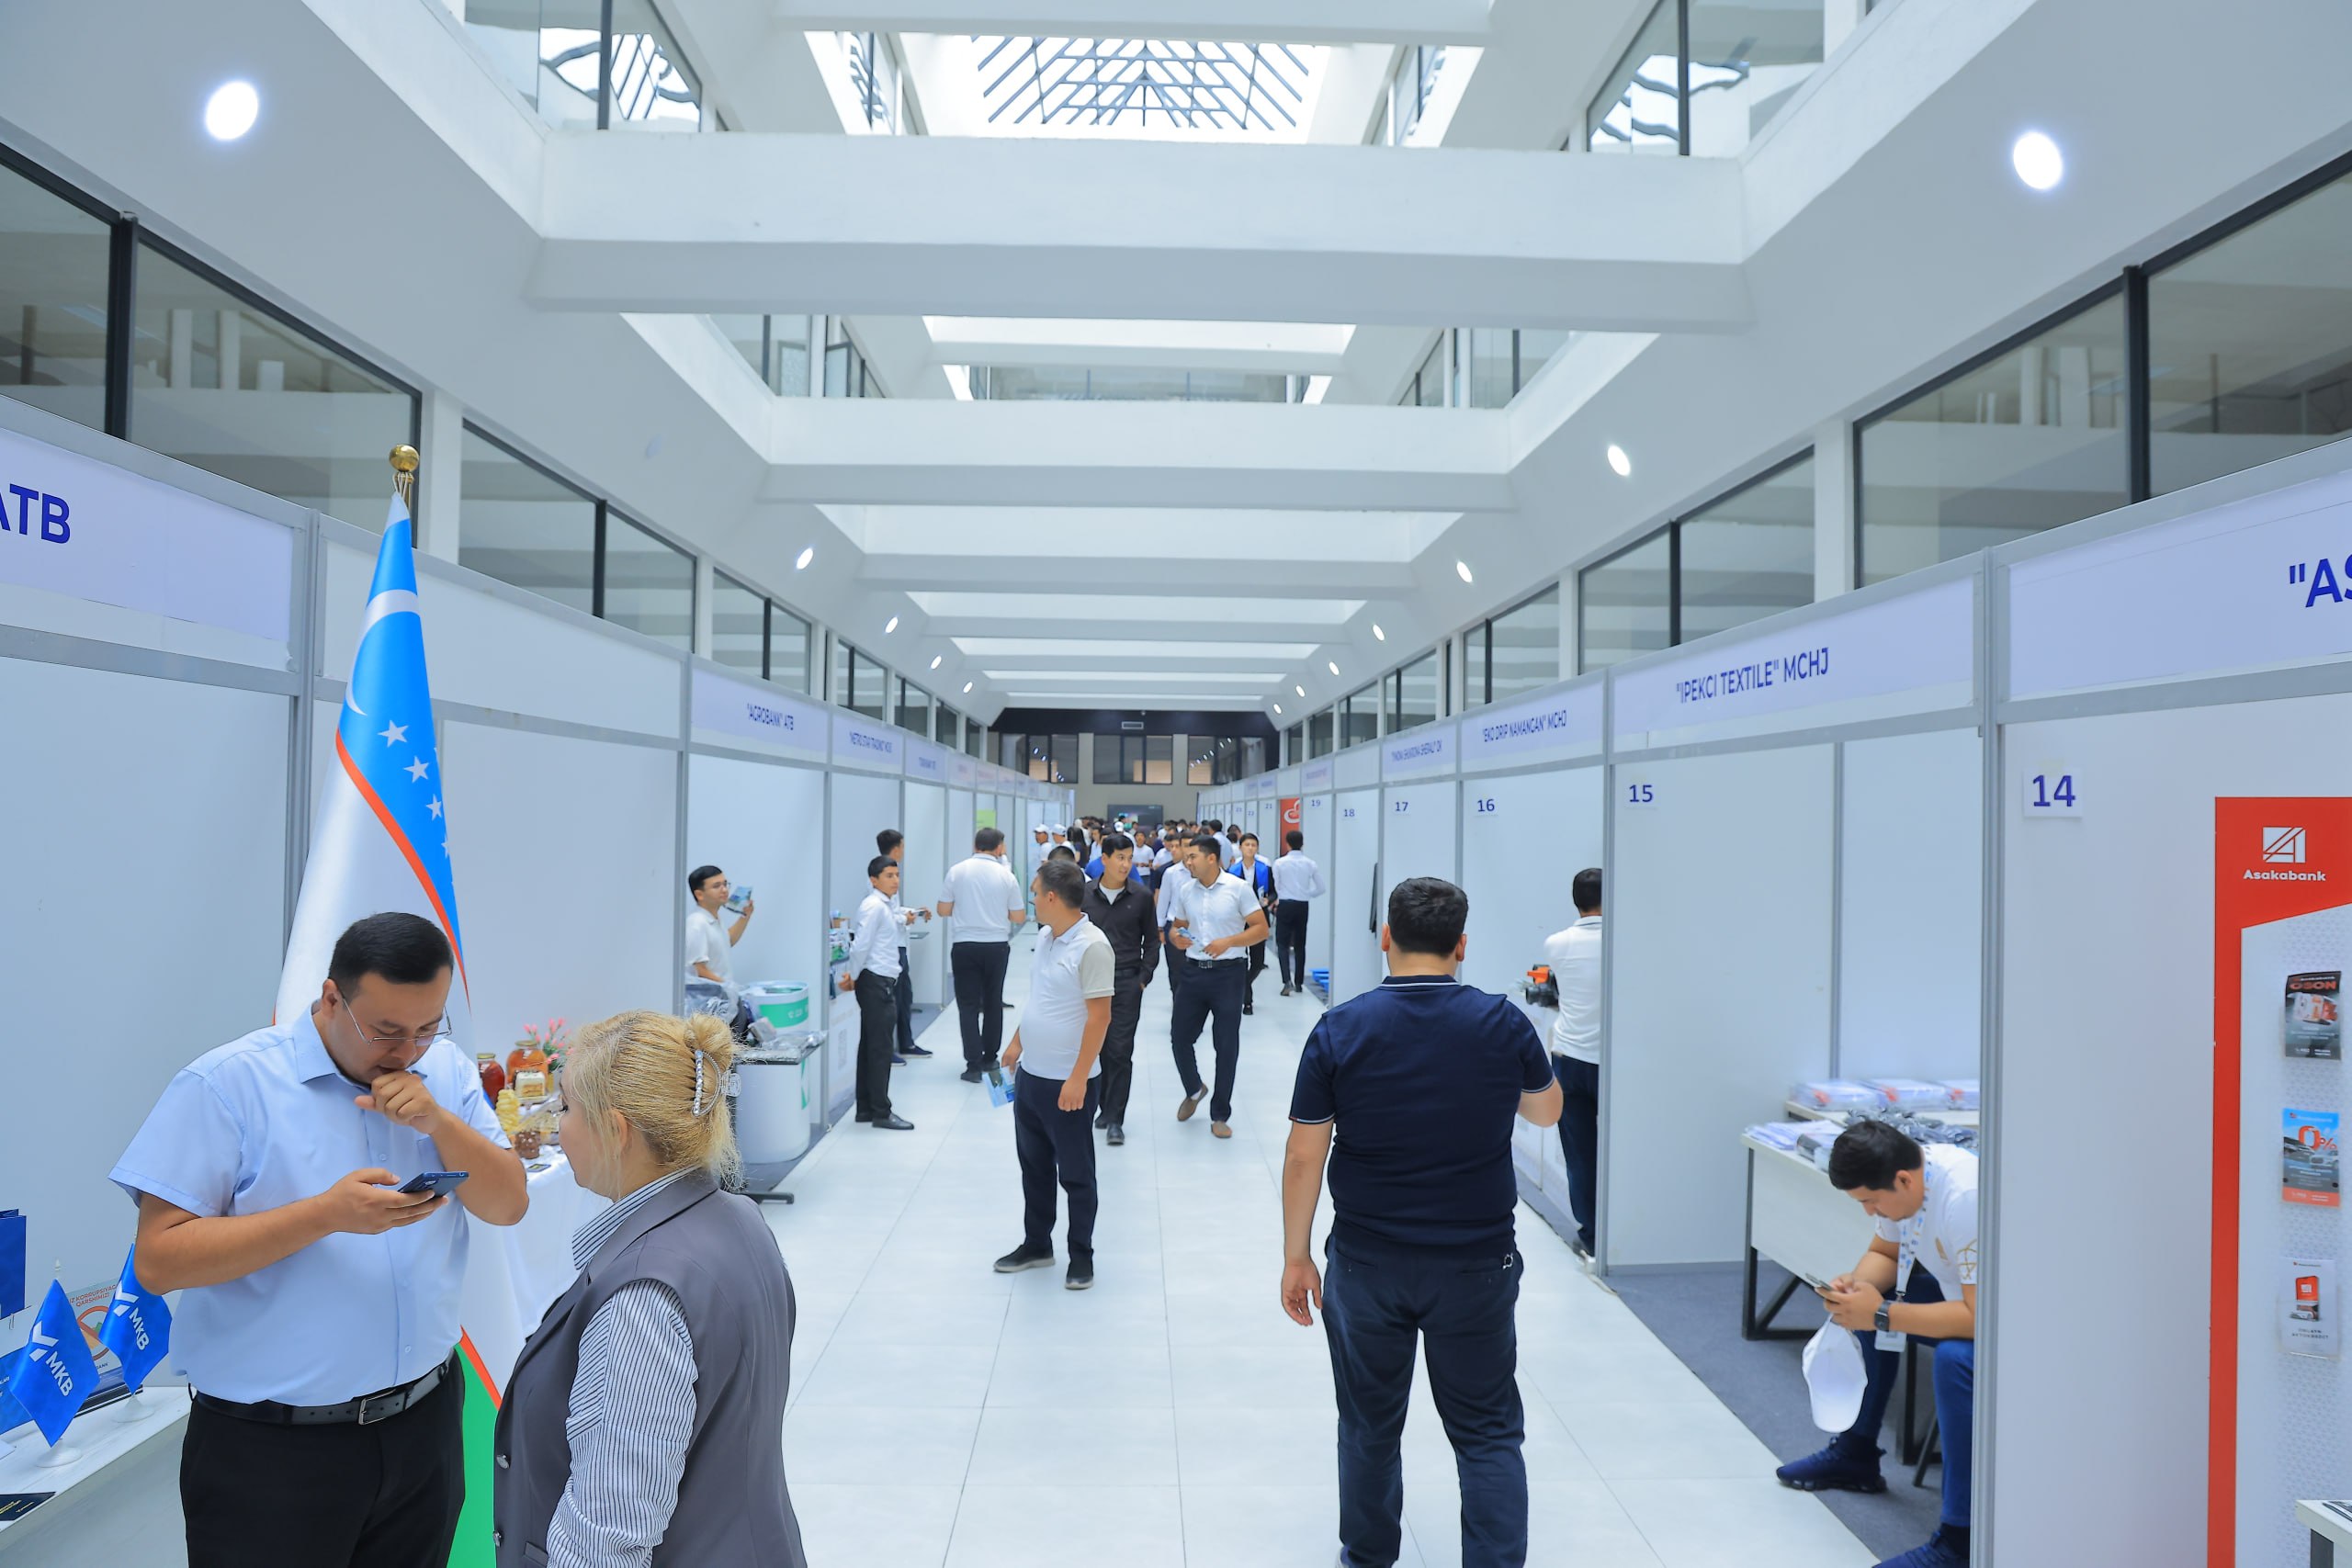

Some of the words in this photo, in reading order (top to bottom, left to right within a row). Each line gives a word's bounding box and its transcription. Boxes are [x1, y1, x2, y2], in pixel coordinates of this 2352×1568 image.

[1676, 674, 1717, 704] "IPEKCI
[1720, 660, 1780, 695] TEXTILE"
[1783, 647, 1829, 683] MCHJ
[1629, 784, 1653, 803] 15
[2032, 774, 2076, 807] 14
[1310, 799, 1321, 807] 19
[1395, 801, 1409, 812] 17
[1477, 798, 1496, 812] 16
[1343, 809, 1355, 818] 18
[2243, 869, 2326, 882] Asakabank
[2289, 981, 2337, 991] OSON
[129, 1307, 150, 1351] MKB
[45, 1350, 74, 1397] MKB
